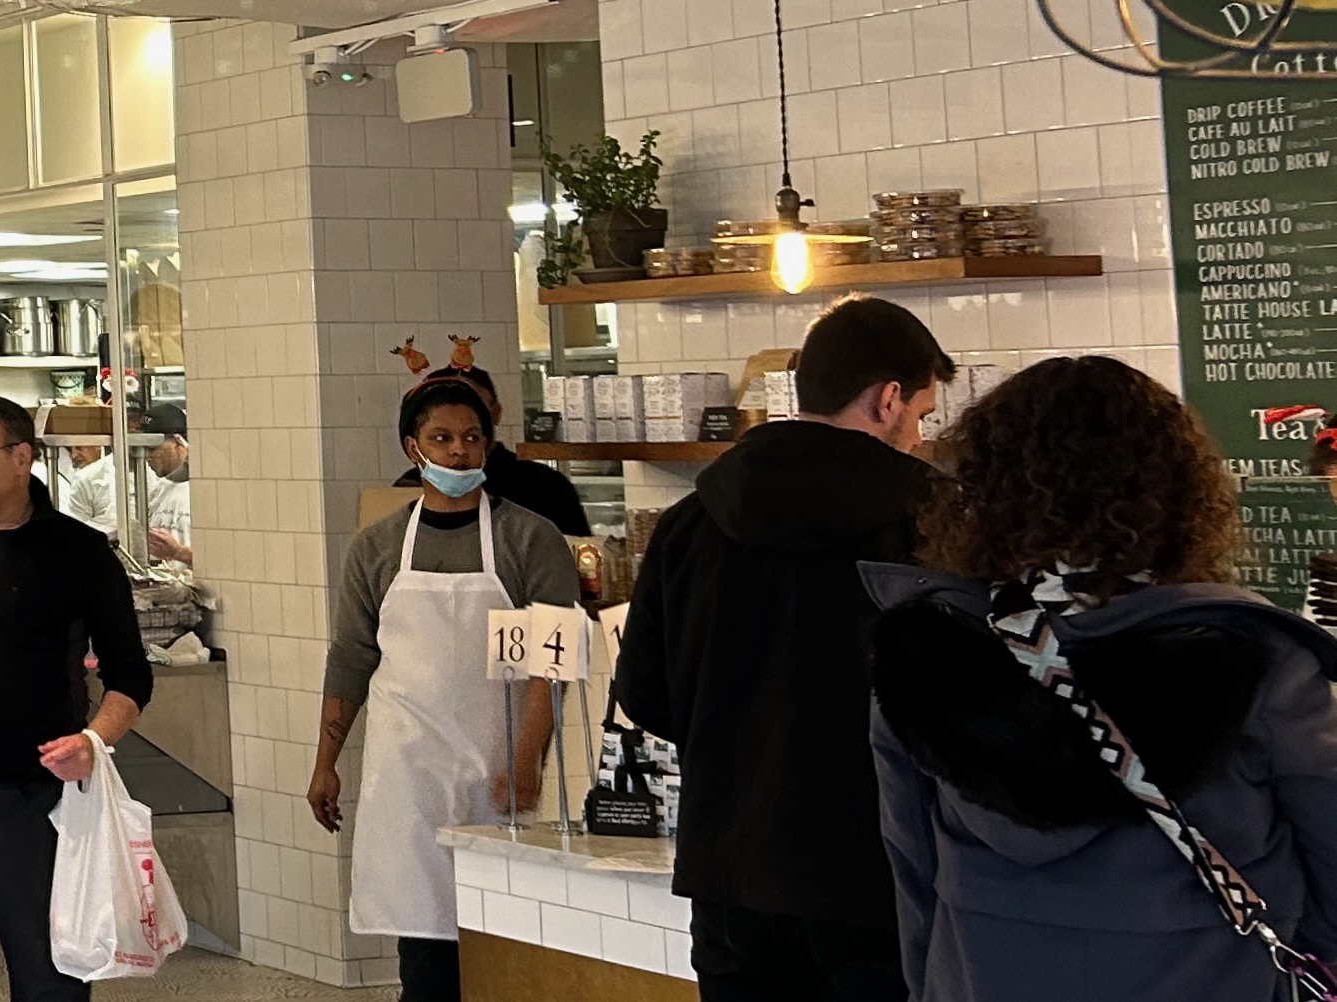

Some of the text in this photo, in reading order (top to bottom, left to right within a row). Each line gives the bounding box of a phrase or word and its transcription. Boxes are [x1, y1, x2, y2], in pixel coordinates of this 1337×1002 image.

[1187, 105, 1221, 124] DRIP
[1227, 96, 1286, 119] COFFEE
[1188, 124, 1224, 141] CAFE
[1230, 122, 1251, 137] AU
[1258, 114, 1297, 134] LAIT
[1190, 142, 1230, 160] COLD
[1236, 135, 1282, 156] BREW
[1190, 150, 1330, 180] NITRO COLD BREW
[1193, 198, 1271, 221] ESPRESSO
[1194, 217, 1292, 240] MACCHIATO
[1197, 241, 1264, 263] CORTADO
[1199, 262, 1292, 283] CAPPUCCINO
[1202, 303, 1250, 321] TATTE
[1258, 301, 1313, 318] HOUSE
[1205, 361, 1337, 382] HOT CHOCOLATE
[1251, 408, 1308, 441] Tea
[1259, 459, 1303, 477] TEAS
[1259, 505, 1292, 524] TEA
[1243, 526, 1286, 546] TCHA
[1269, 548, 1326, 565] LATT
[494, 626, 525, 662] 18
[542, 622, 565, 666] 4
